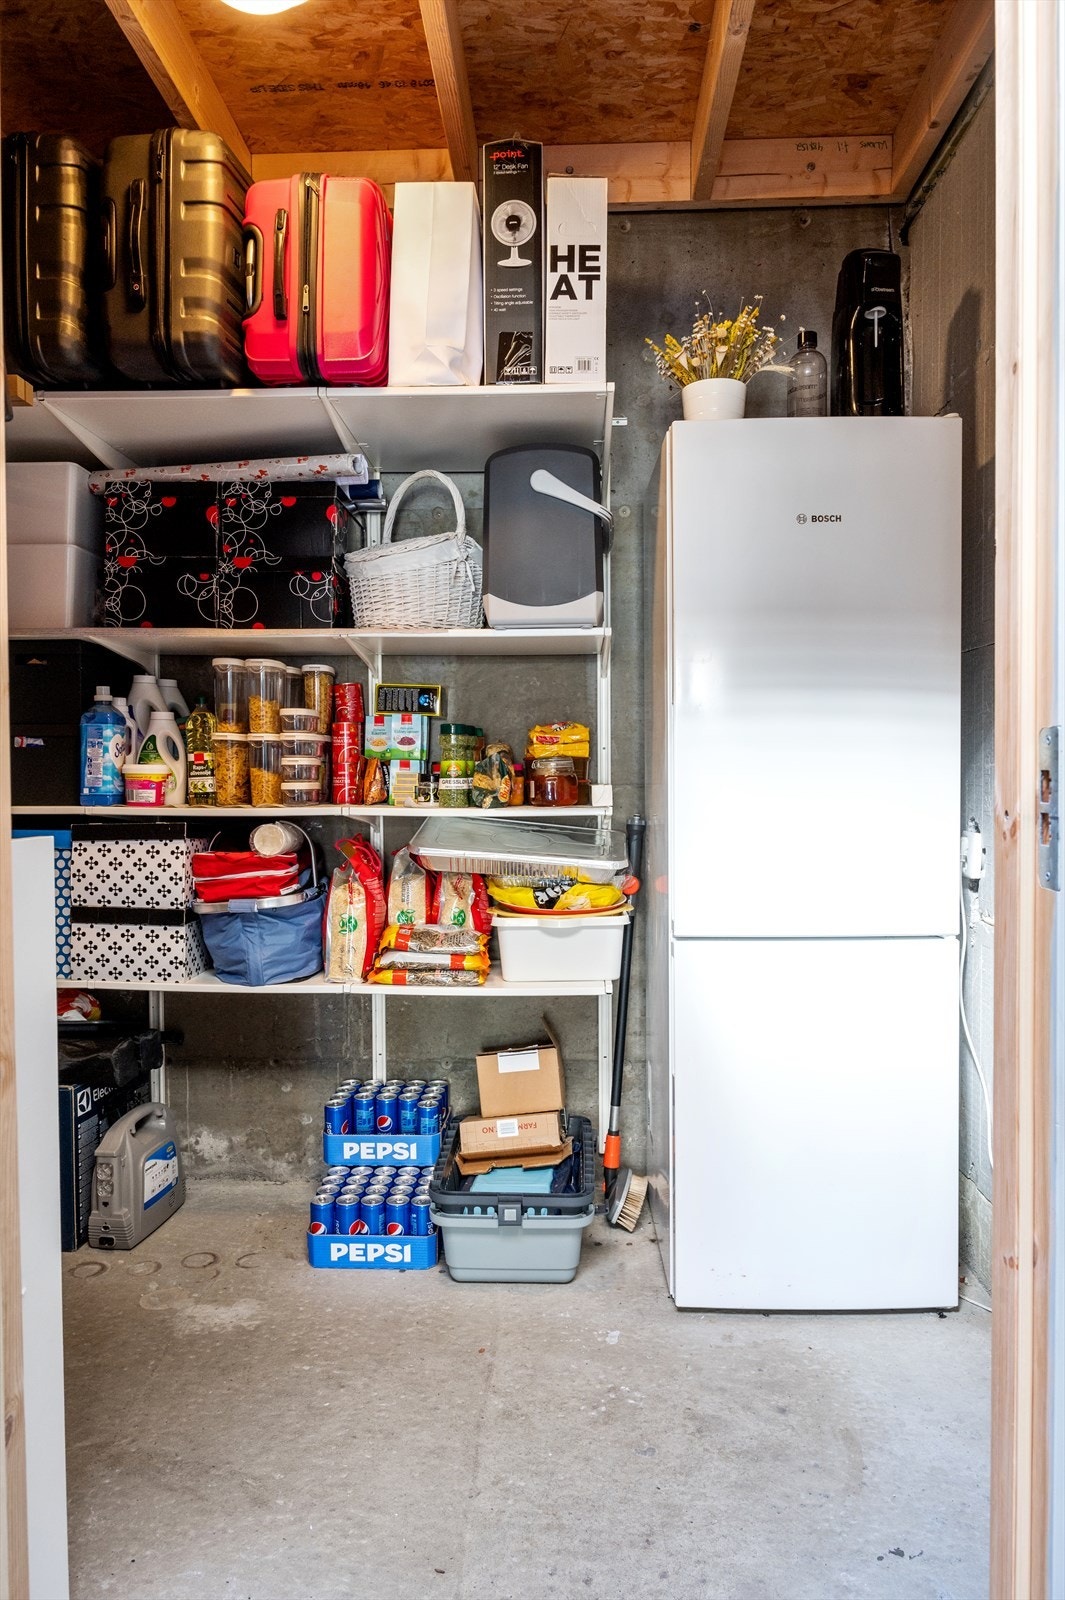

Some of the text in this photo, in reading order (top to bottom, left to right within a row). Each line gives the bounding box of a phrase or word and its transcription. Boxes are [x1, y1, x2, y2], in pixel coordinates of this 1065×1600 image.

[490, 150, 525, 160] point
[811, 514, 842, 523] BOSCH
[343, 1142, 417, 1160] PEPSI
[330, 1243, 411, 1263] PEPSI
